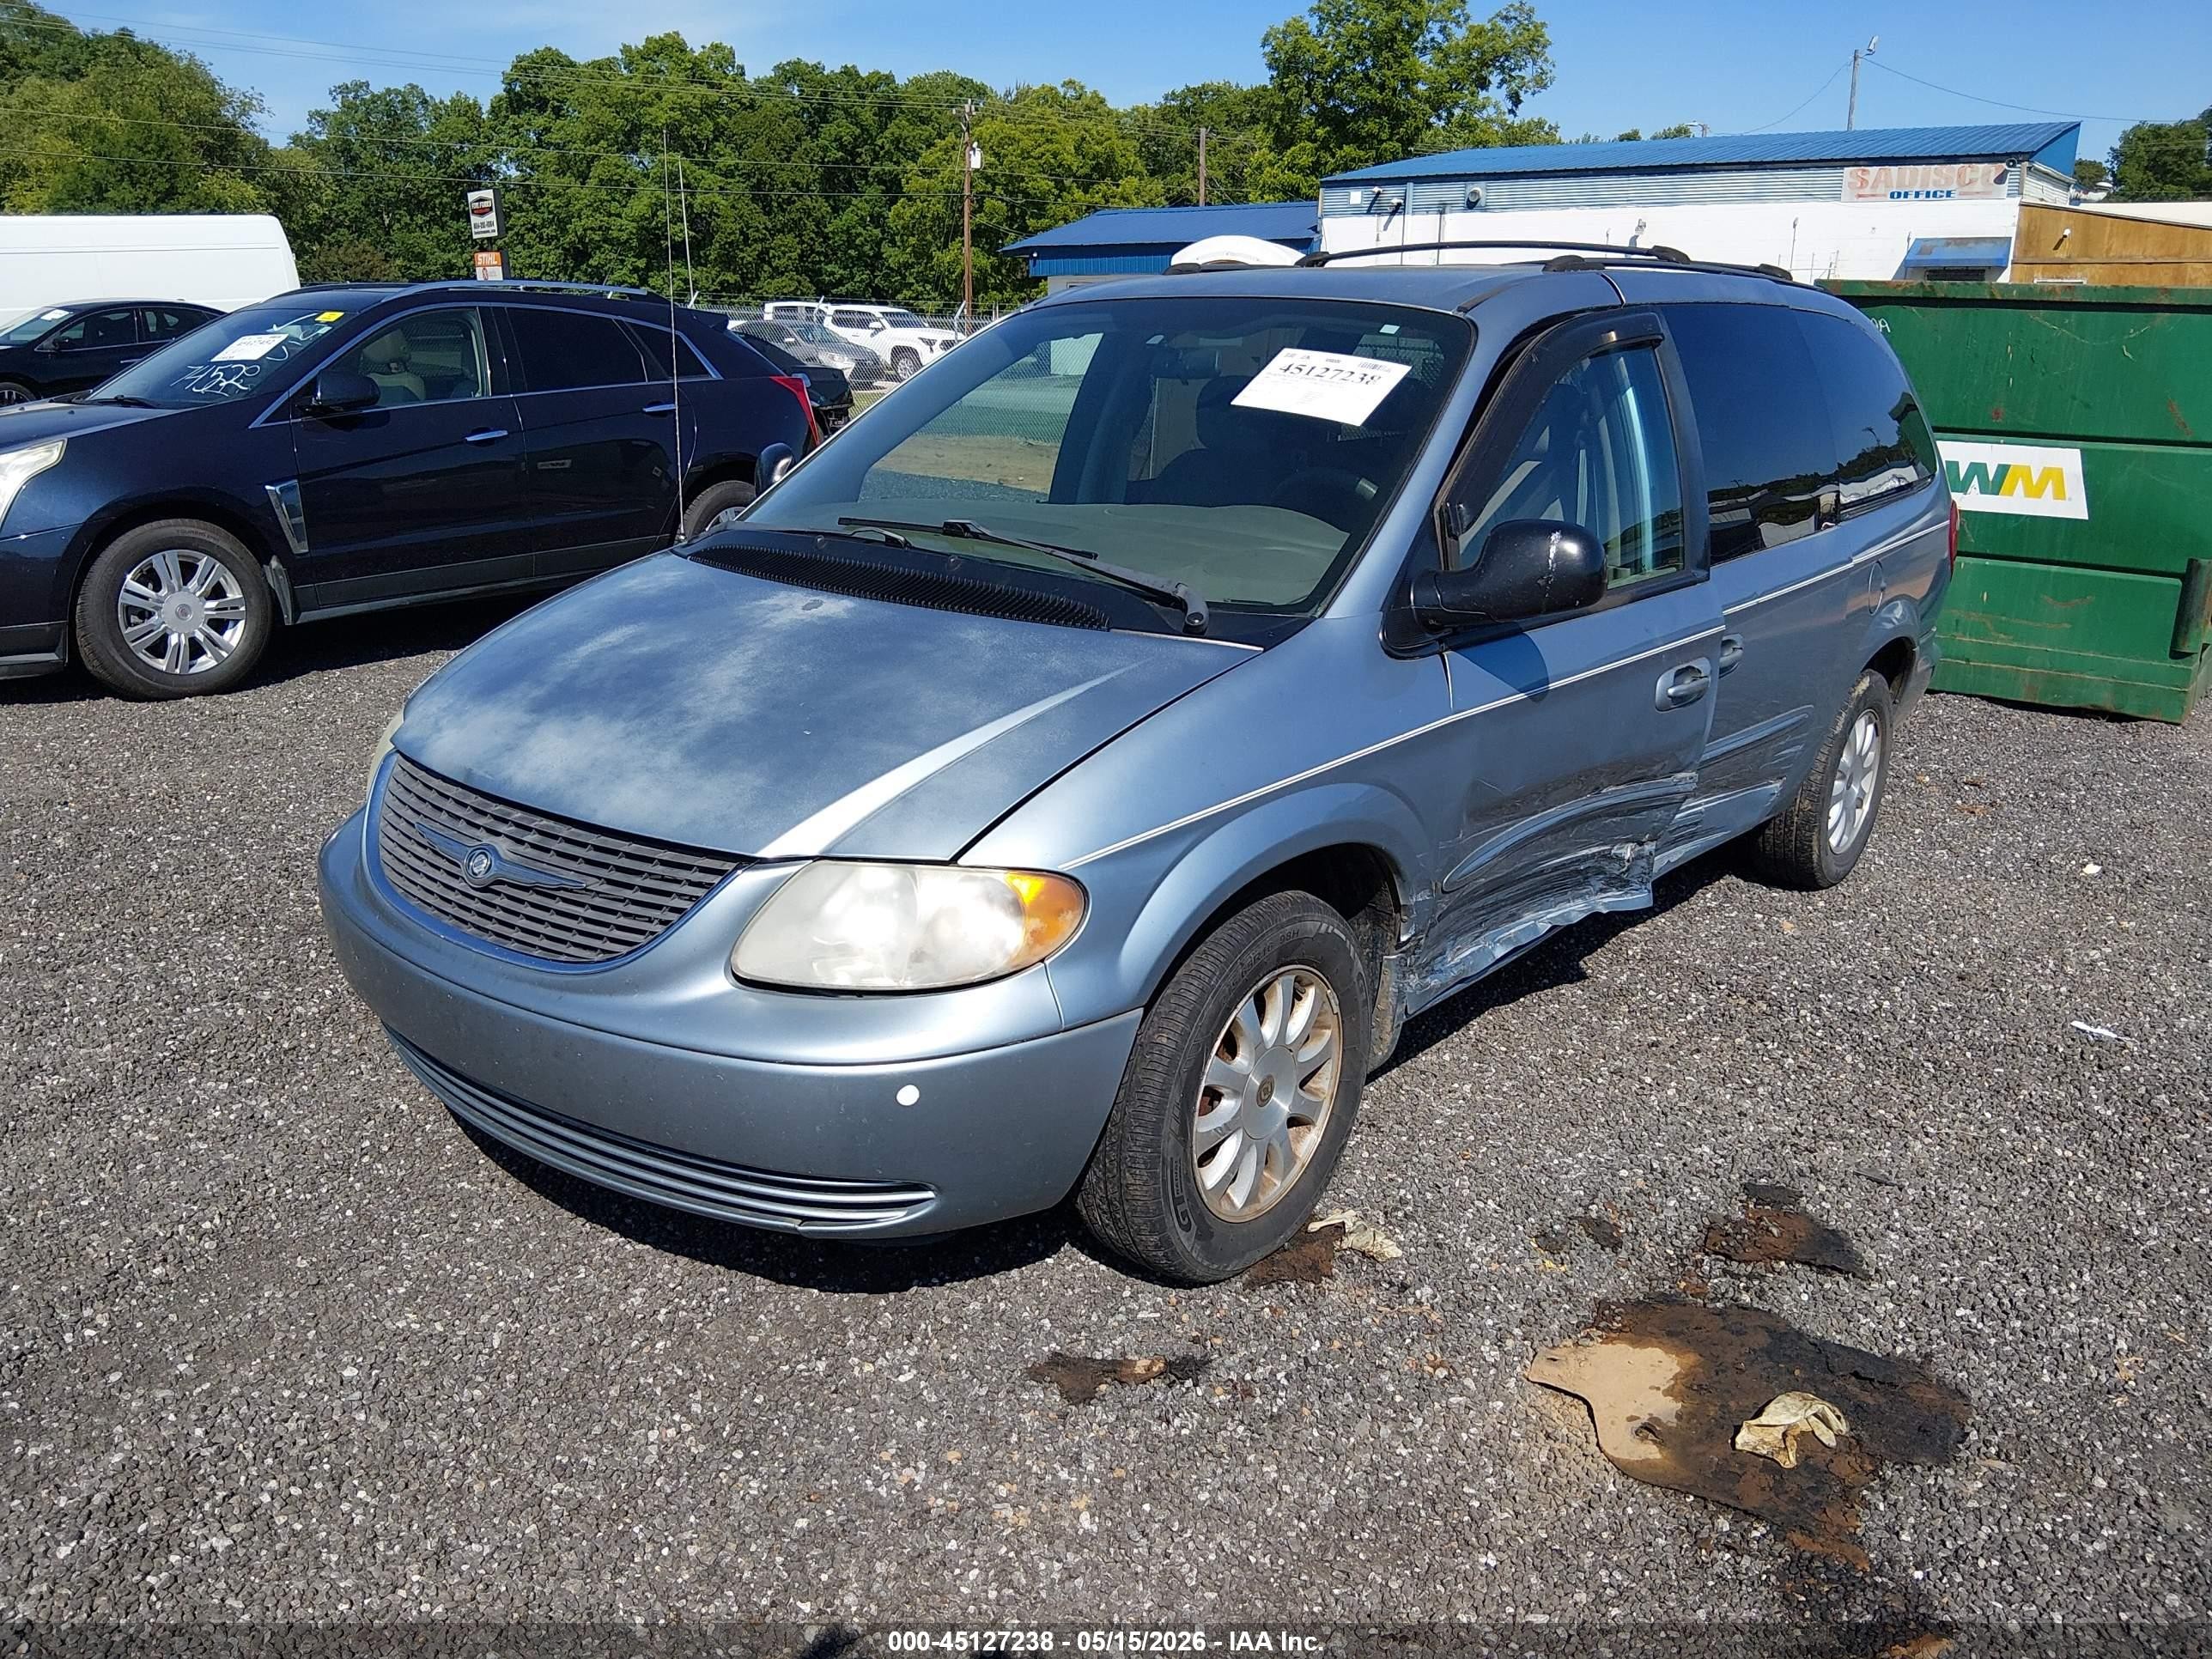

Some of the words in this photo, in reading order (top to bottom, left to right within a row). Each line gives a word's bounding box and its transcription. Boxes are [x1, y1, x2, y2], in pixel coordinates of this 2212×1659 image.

[1889, 189, 1957, 199] OFFICE
[477, 253, 498, 265] STIHL
[1279, 362, 1382, 386] 45127238
[1944, 459, 2067, 501] WM
